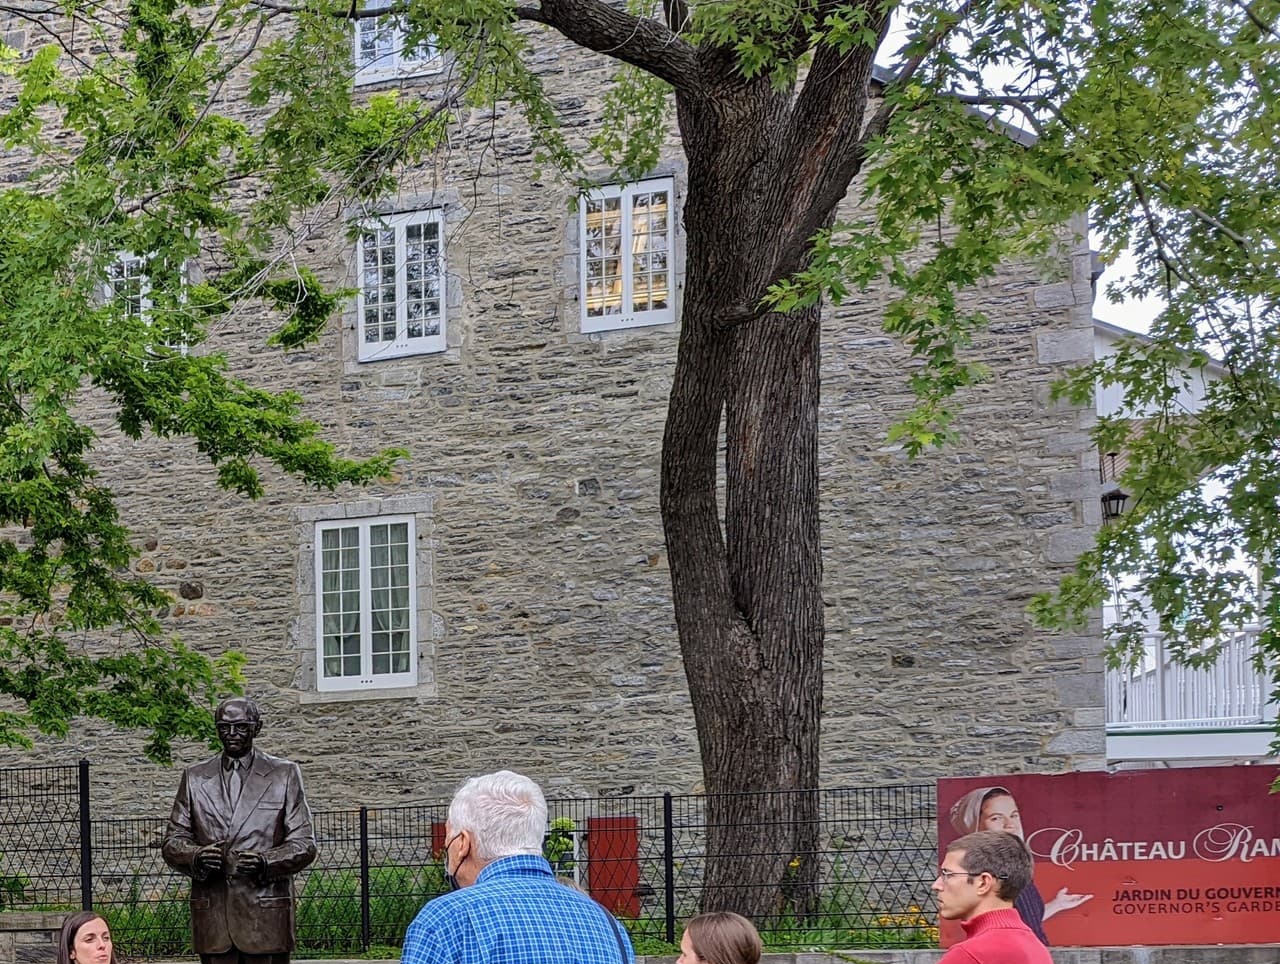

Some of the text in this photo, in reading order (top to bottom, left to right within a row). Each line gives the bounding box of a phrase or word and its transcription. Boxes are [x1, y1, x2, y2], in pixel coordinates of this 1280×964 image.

[1026, 827, 1185, 871] CHÂTEAU
[1112, 889, 1171, 902] JARDIN
[1176, 887, 1200, 901] DU
[1113, 901, 1220, 915] GOVERNOR'S
